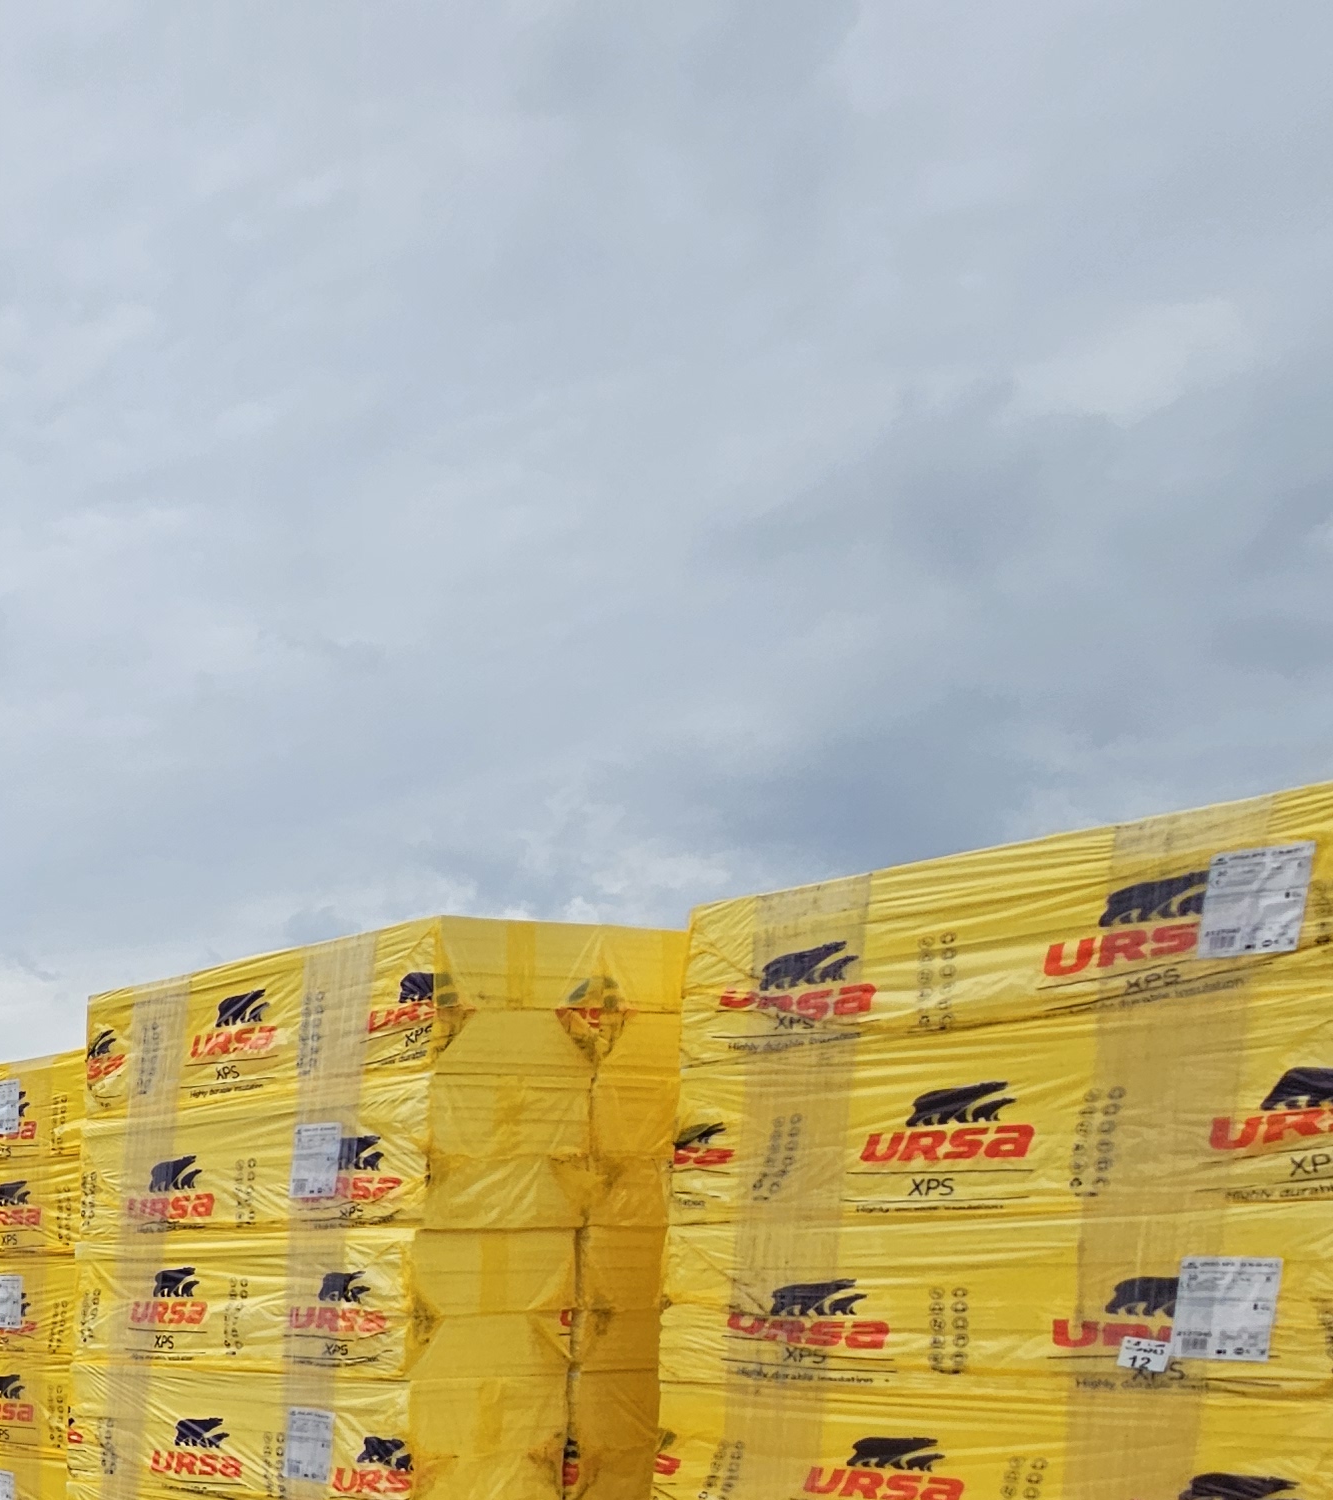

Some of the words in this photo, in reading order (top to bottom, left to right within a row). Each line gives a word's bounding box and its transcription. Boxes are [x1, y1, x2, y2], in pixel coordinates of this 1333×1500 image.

[1043, 922, 1200, 977] URS
[1124, 968, 1182, 993] XPS
[719, 983, 878, 1021] URSA
[368, 1001, 437, 1035] URS
[189, 1025, 278, 1059] URSA
[87, 1053, 126, 1080] SA
[215, 1064, 241, 1081] XPS
[859, 1124, 1035, 1164] URSA
[1289, 1152, 1333, 1178] XP
[335, 1175, 404, 1201] RSA
[907, 1177, 956, 1197] XPS
[126, 1192, 215, 1220] URSA
[0, 1233, 18, 1246] XPS
[130, 1300, 209, 1326] URSA
[290, 1306, 388, 1334] URSA
[154, 1334, 175, 1350] XPS
[727, 1312, 890, 1350] URSA
[321, 1342, 349, 1357] XPS
[783, 1346, 828, 1364] XPS
[1128, 1355, 1152, 1370] 12
[150, 1449, 244, 1479] URSA
[332, 1467, 415, 1494] URS
